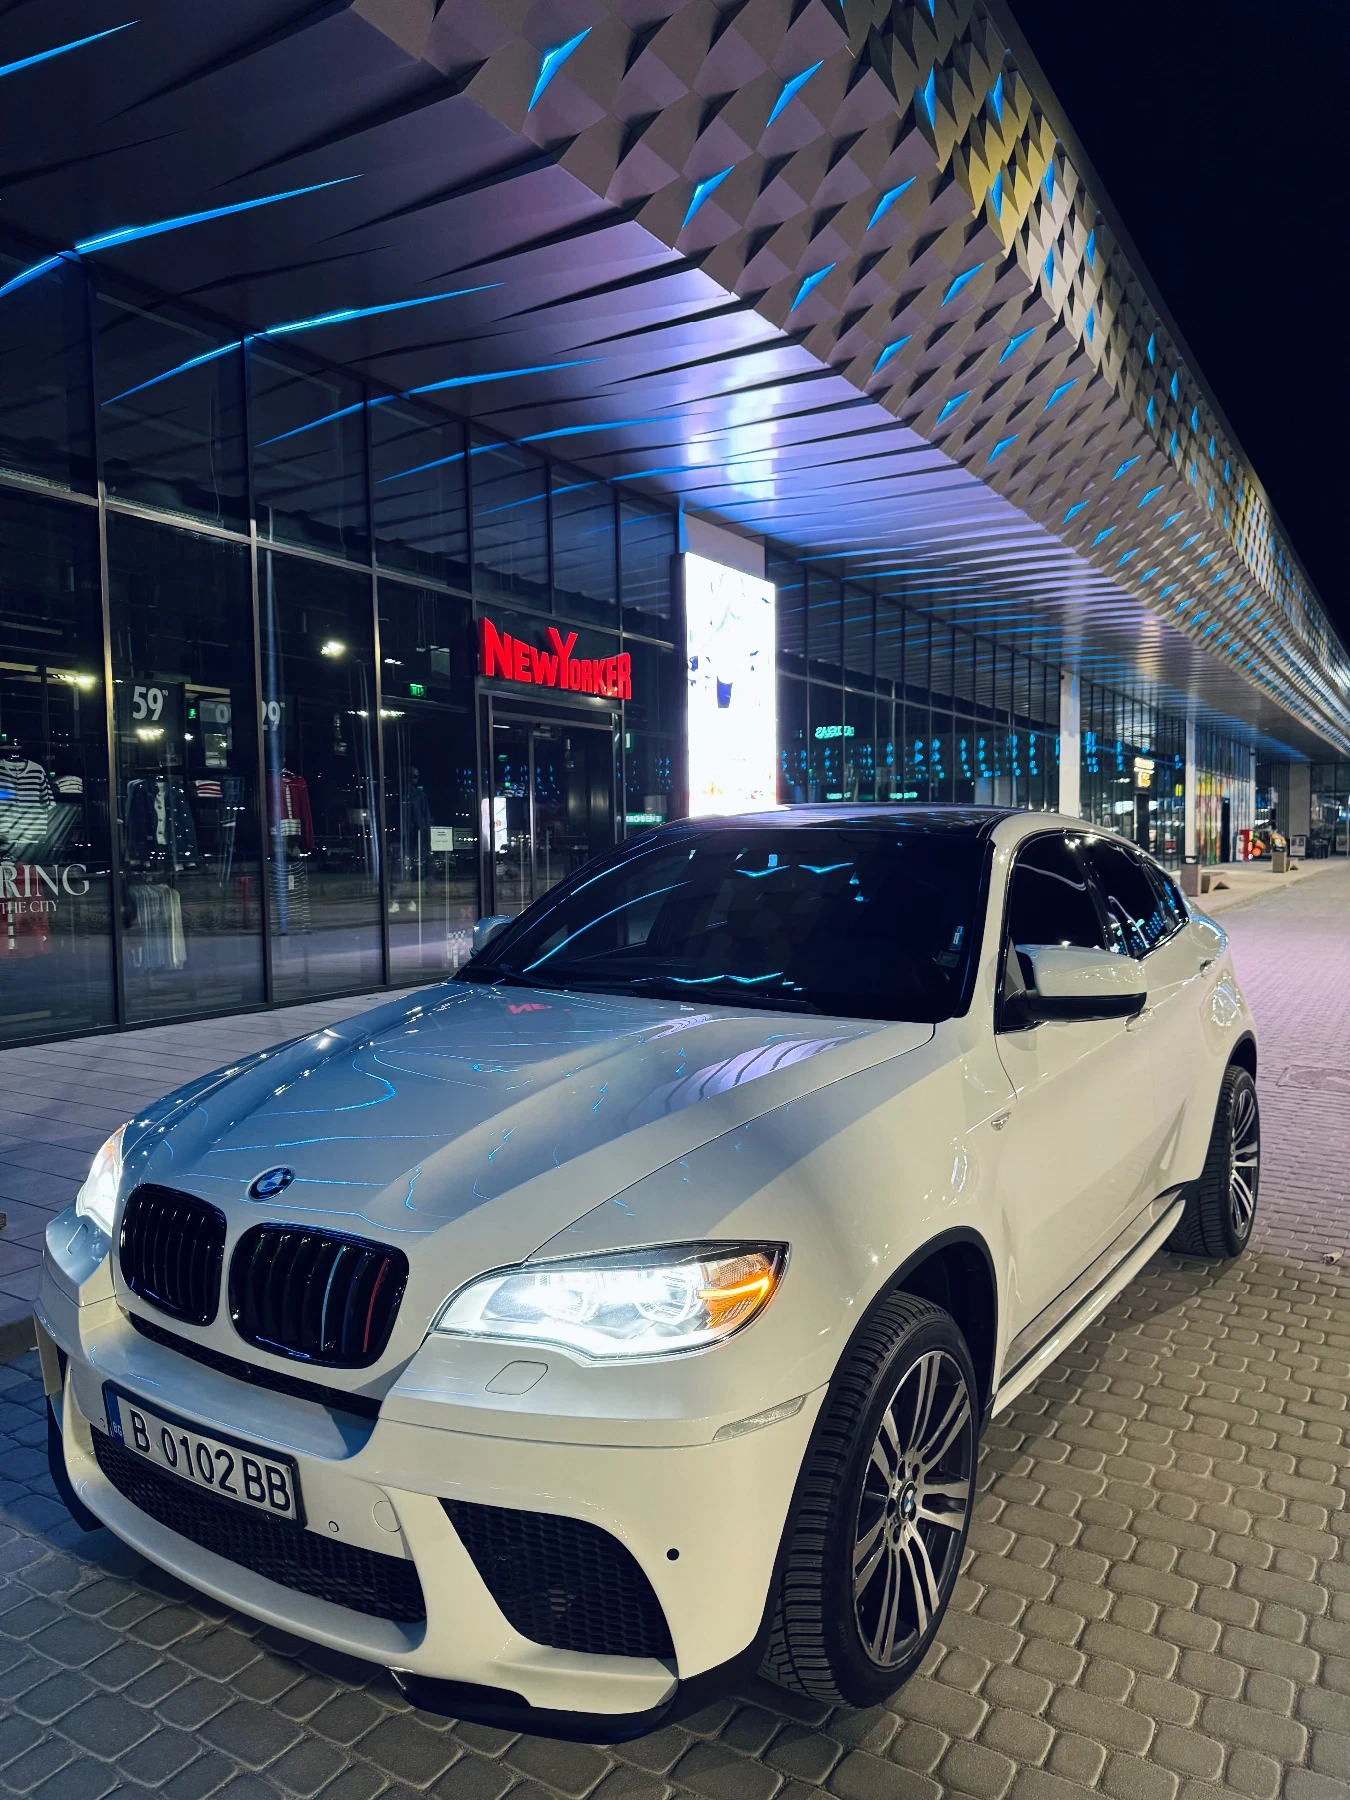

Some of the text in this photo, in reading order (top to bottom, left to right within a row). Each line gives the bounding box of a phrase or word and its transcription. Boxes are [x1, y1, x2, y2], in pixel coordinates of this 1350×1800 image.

[132, 685, 164, 721] 59
[0, 863, 90, 898] RING
[29, 899, 60, 913] CITY
